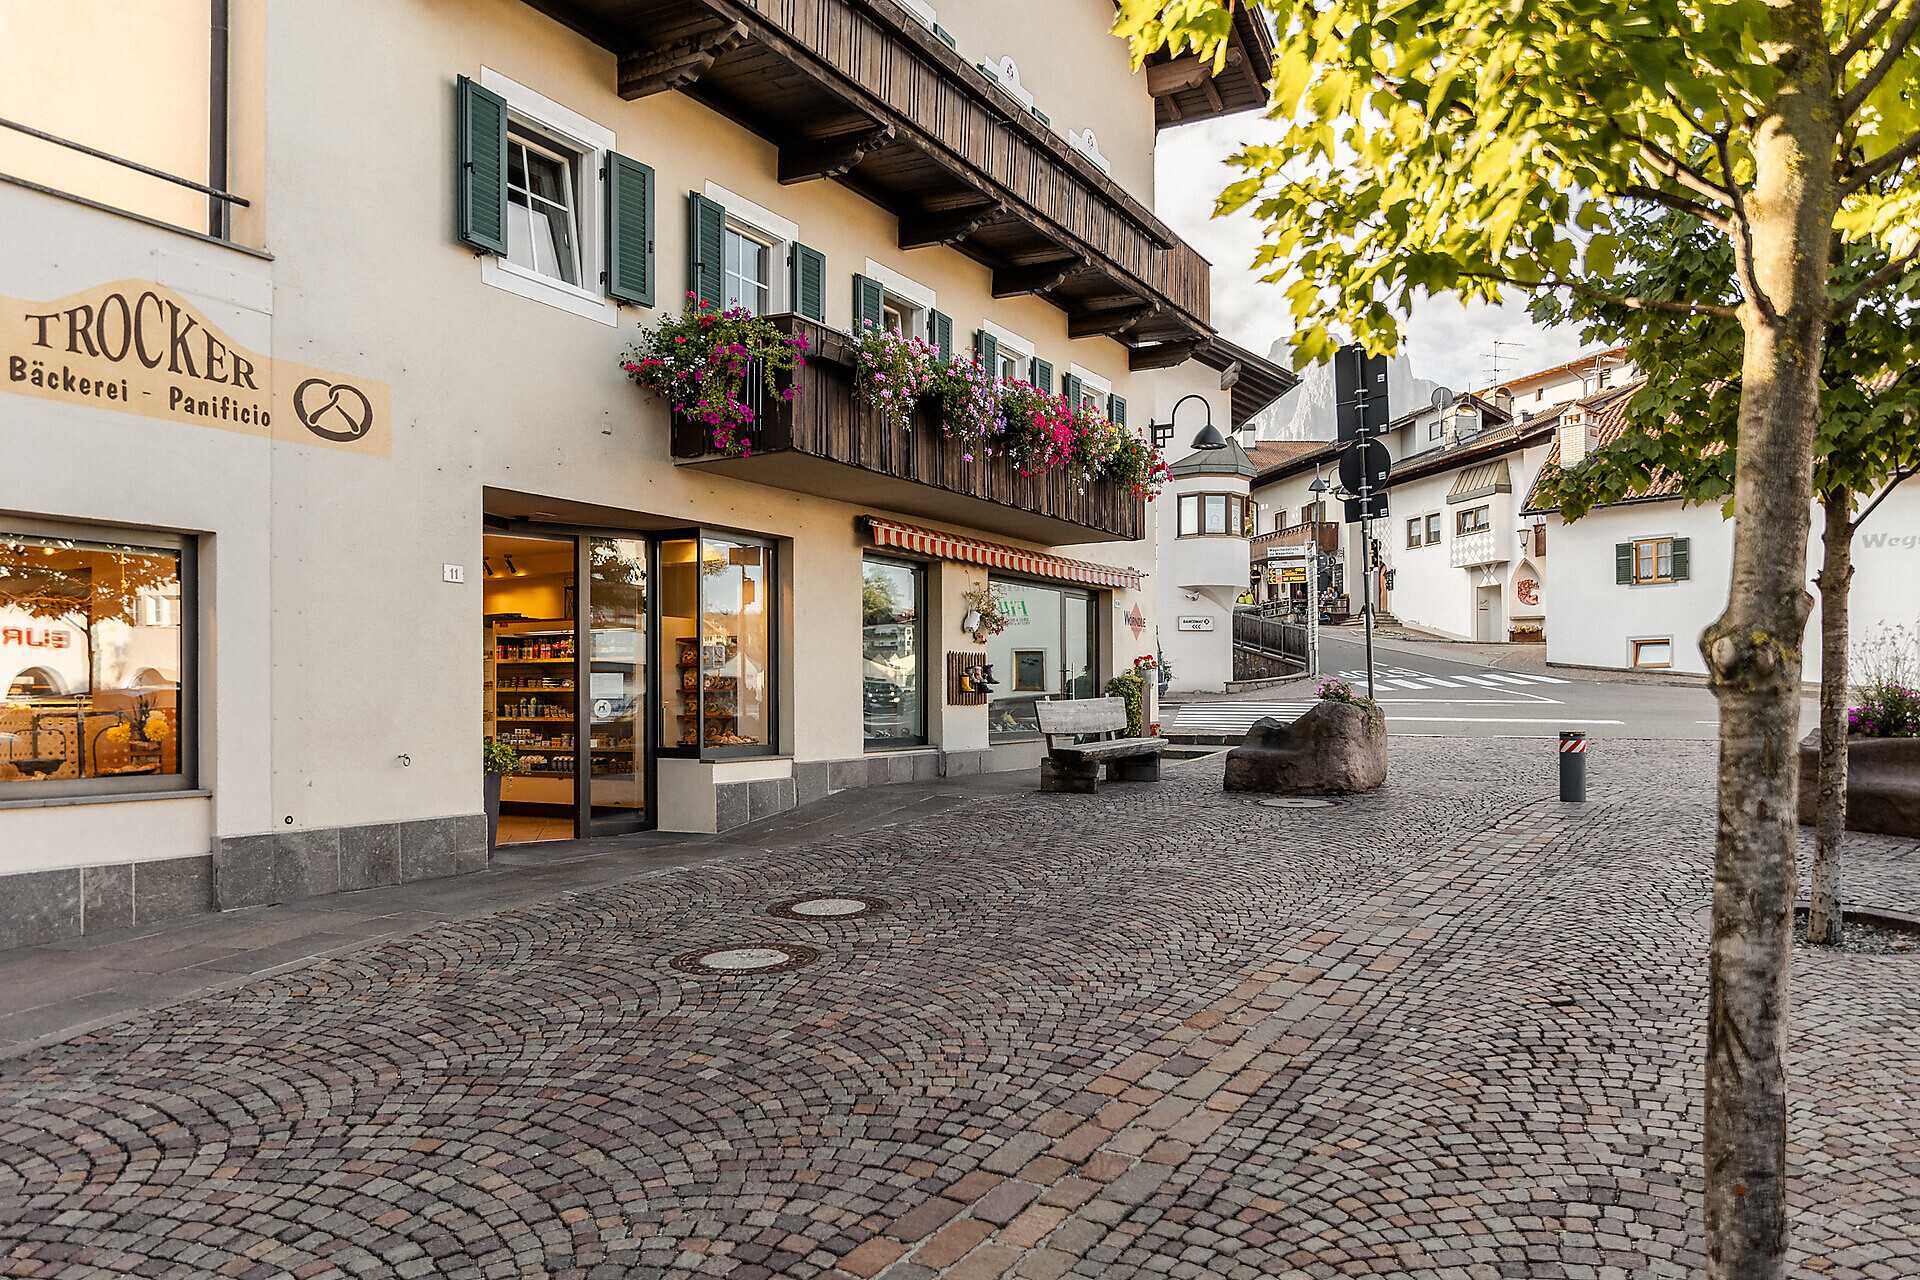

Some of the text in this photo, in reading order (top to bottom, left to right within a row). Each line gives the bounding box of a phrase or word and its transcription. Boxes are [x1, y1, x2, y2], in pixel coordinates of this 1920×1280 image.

[25, 291, 260, 390] TROCKER
[9, 355, 128, 402] Bäckerei
[169, 385, 272, 428] Panificio
[1861, 533, 1920, 550] Weg
[450, 567, 459, 580] 11
